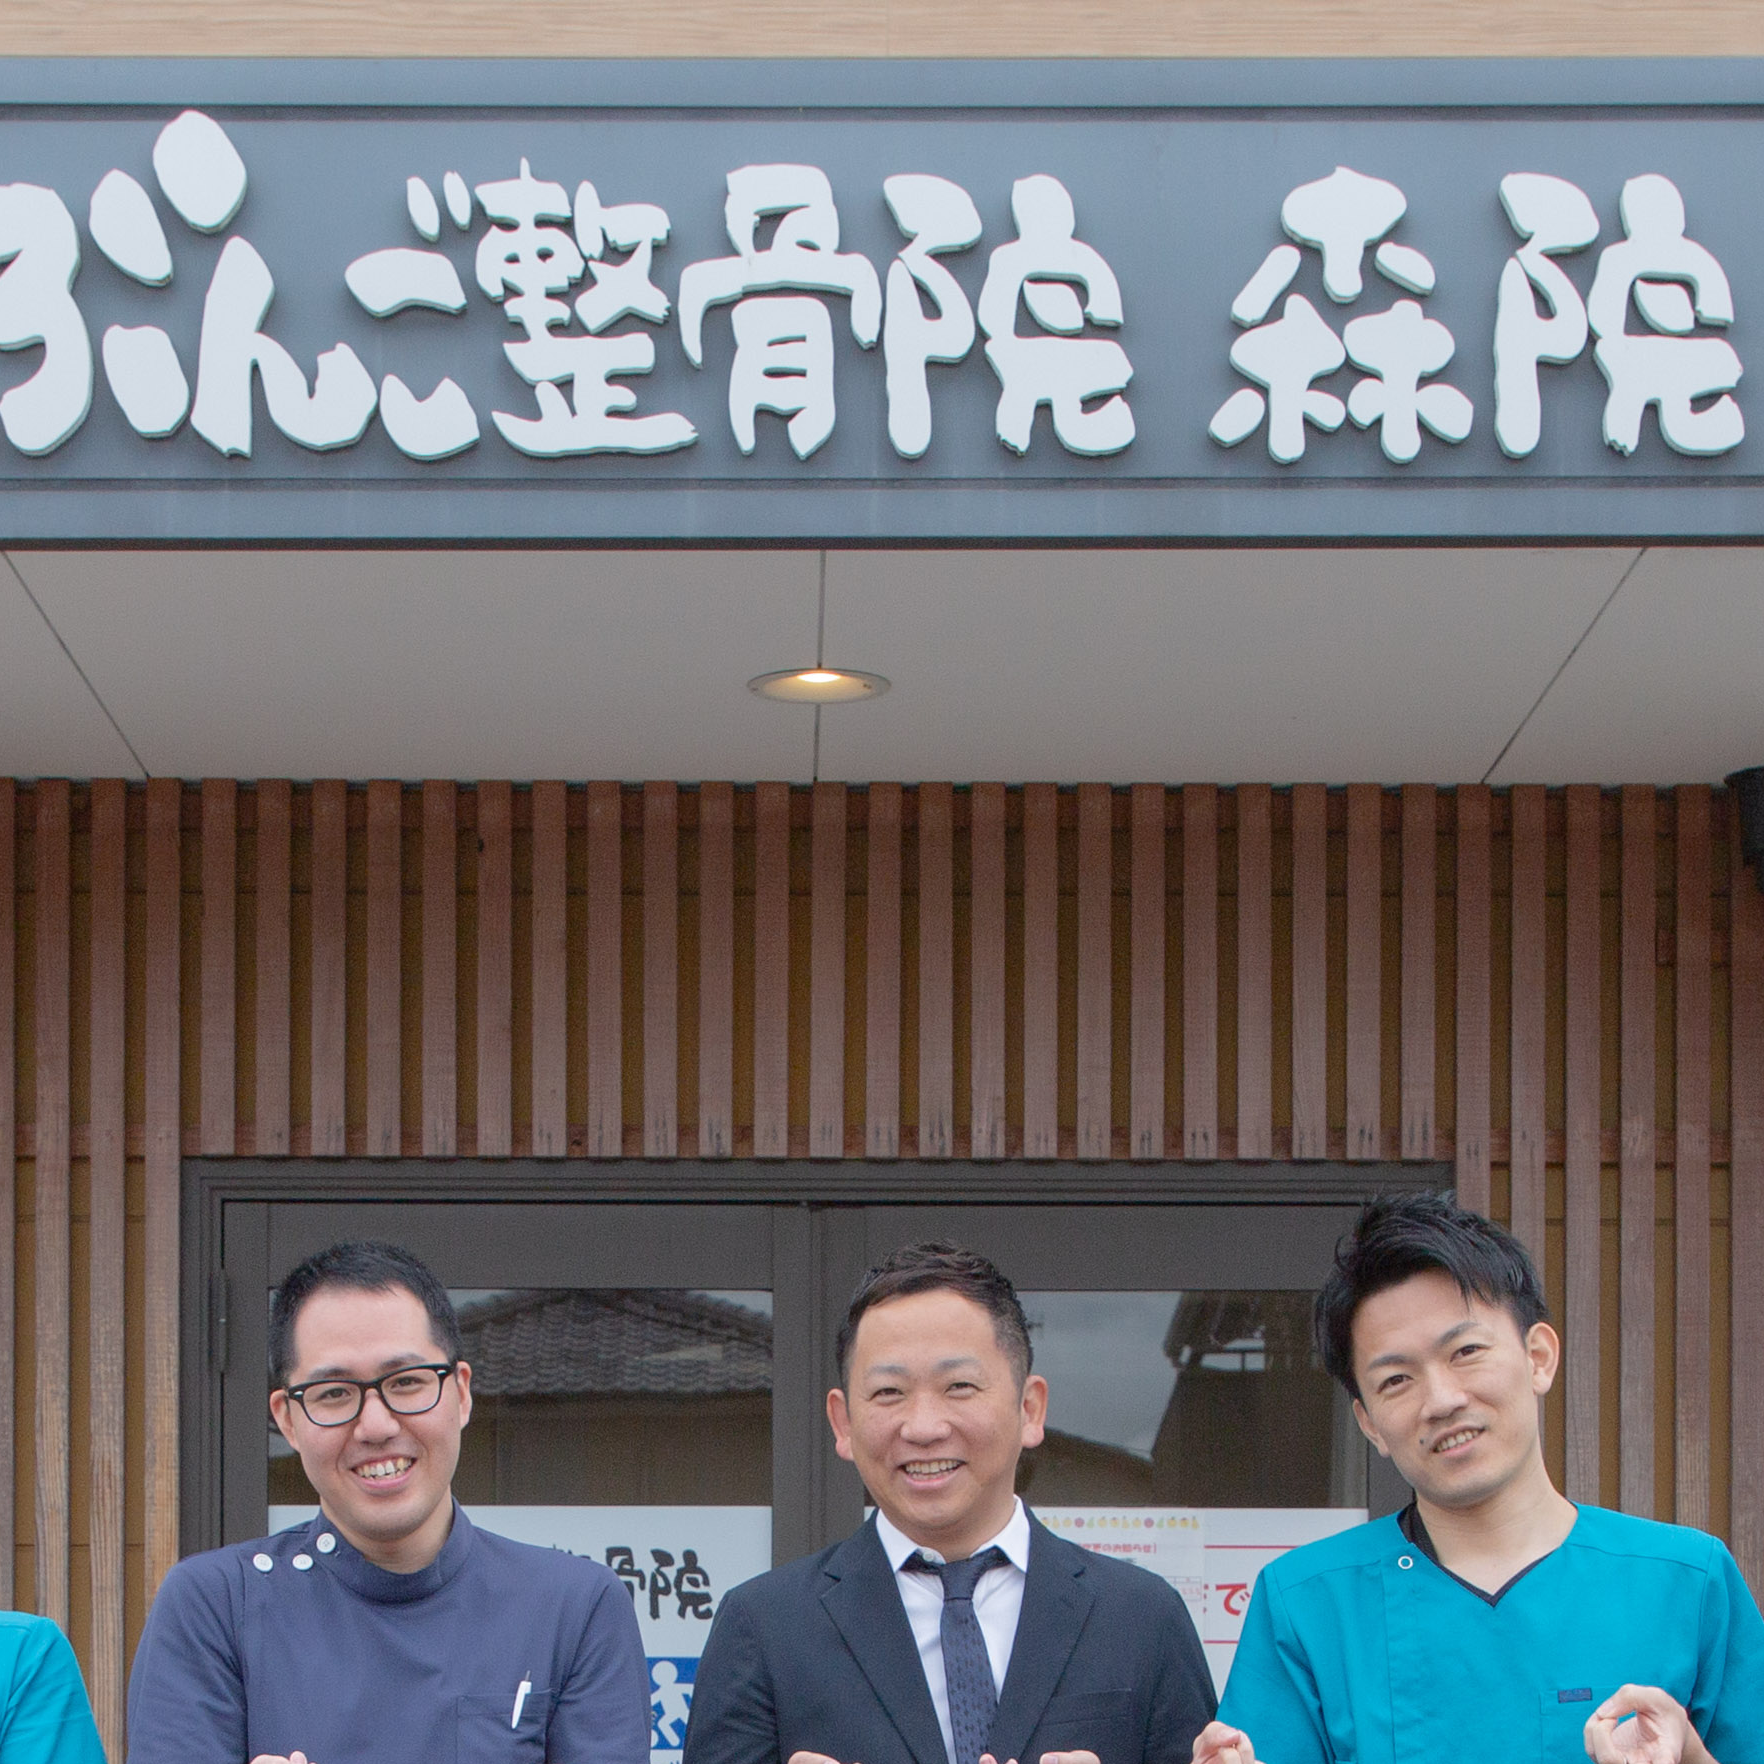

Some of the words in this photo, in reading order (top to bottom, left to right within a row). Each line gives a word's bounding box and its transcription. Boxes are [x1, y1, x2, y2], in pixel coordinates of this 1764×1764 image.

[1210, 166, 1745, 463] 森院
[553, 1544, 714, 1621] 骨院
[1203, 1582, 1251, 1617] で
